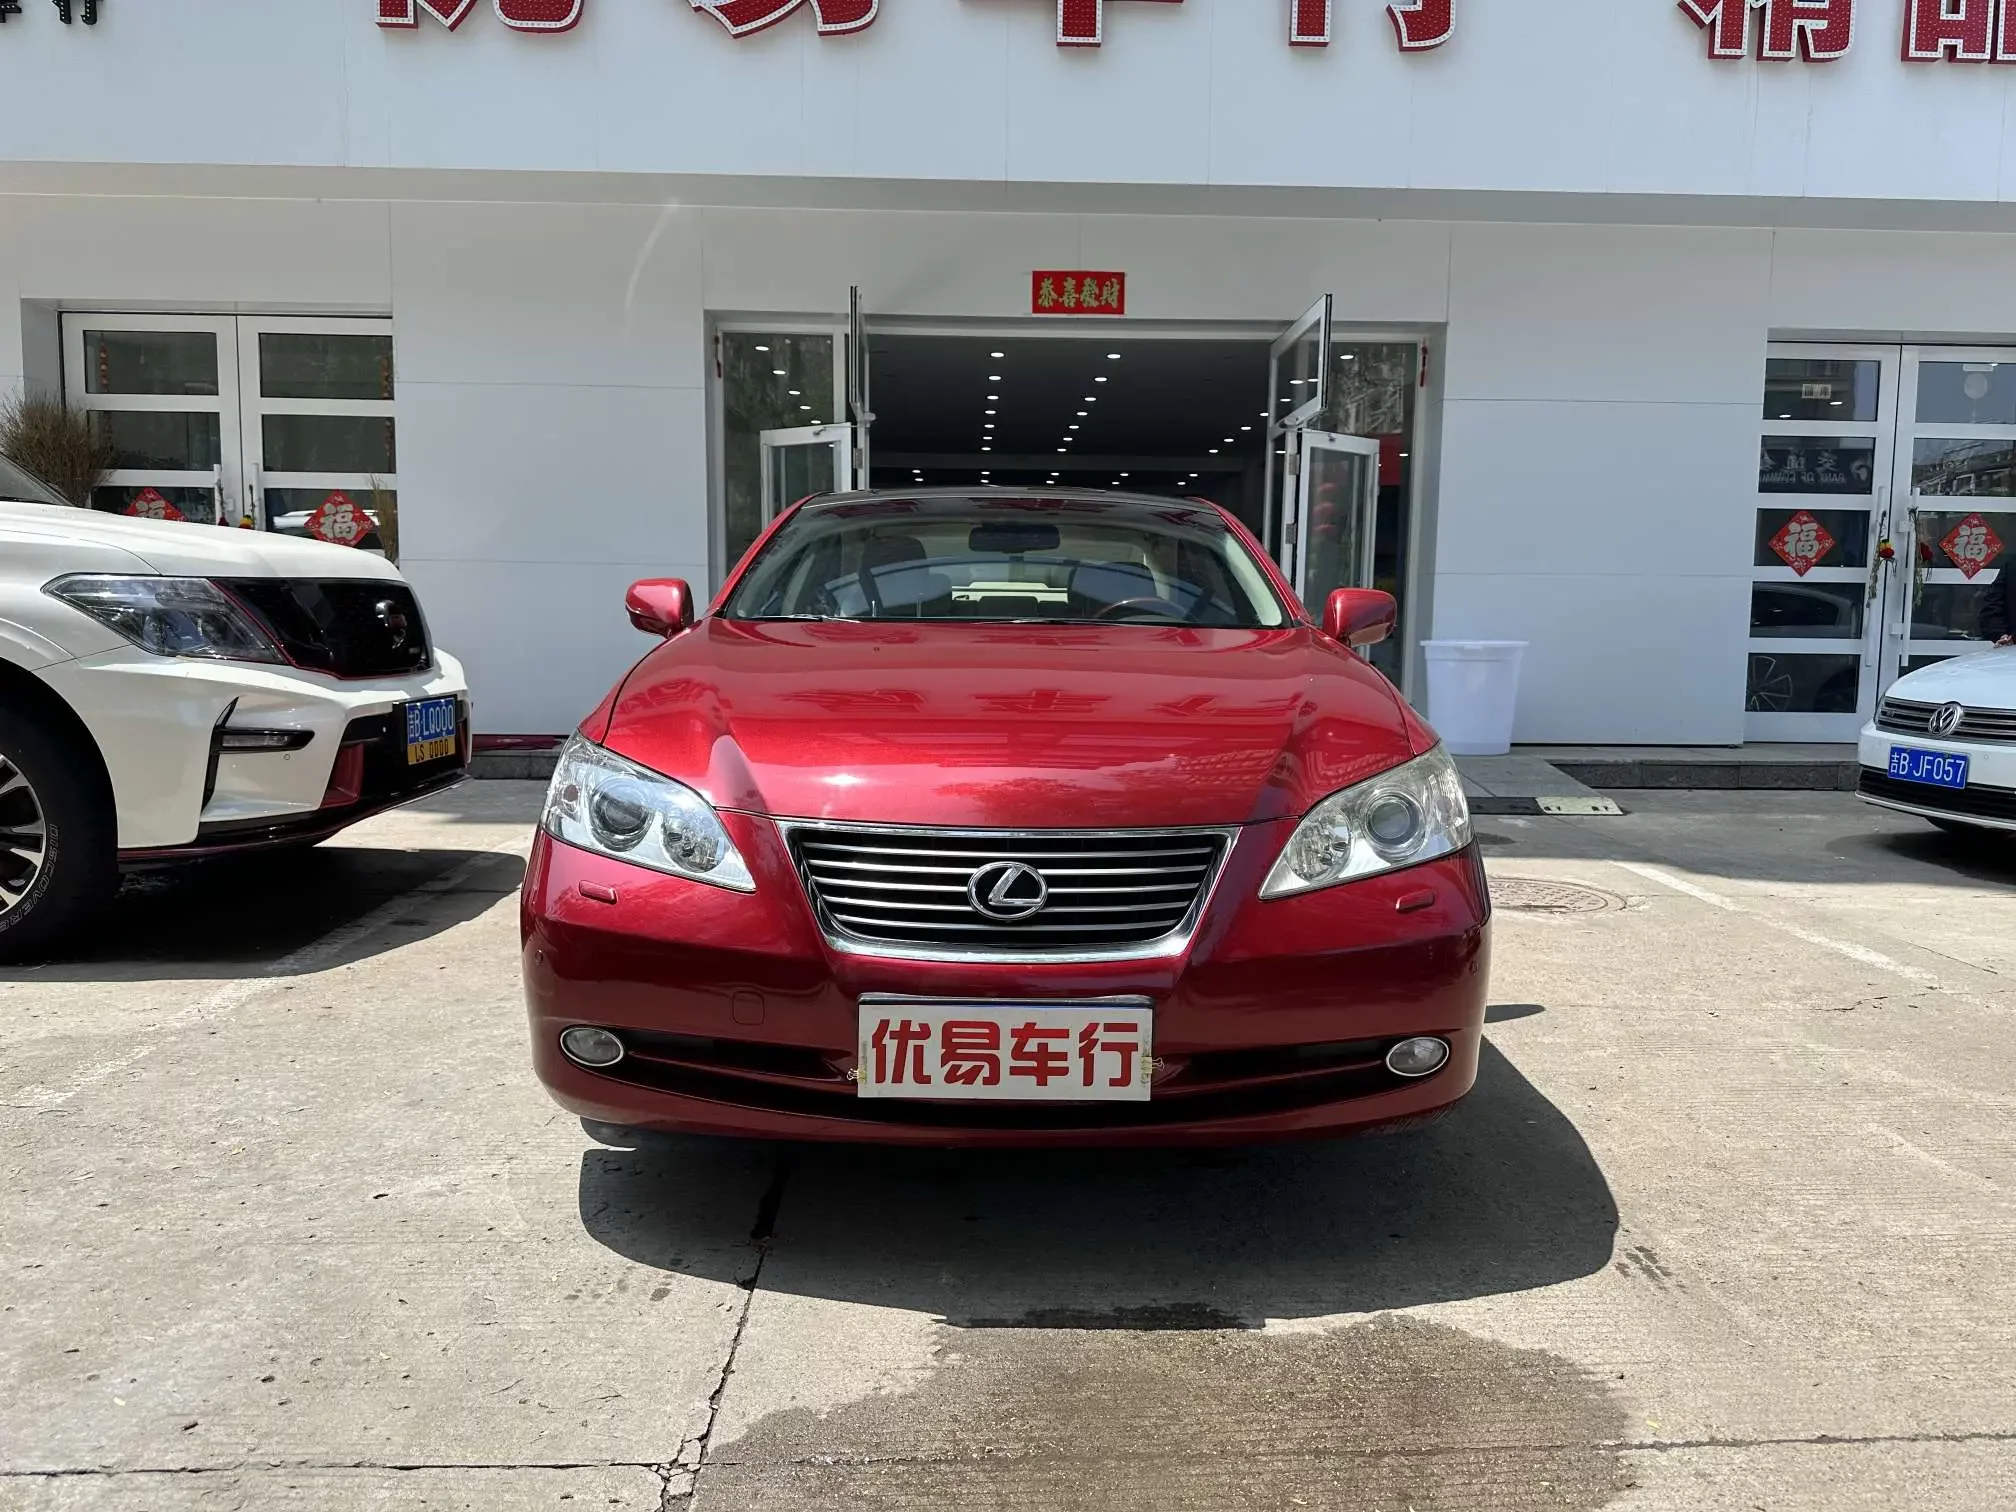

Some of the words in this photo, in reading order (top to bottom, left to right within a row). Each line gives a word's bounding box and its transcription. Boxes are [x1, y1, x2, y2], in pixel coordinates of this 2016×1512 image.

[1038, 276, 1120, 309] 恭喜發財
[320, 503, 358, 540] 福
[1784, 522, 1819, 559] 福
[1953, 525, 1989, 561] 福
[871, 1018, 1139, 1087] 优易车行
